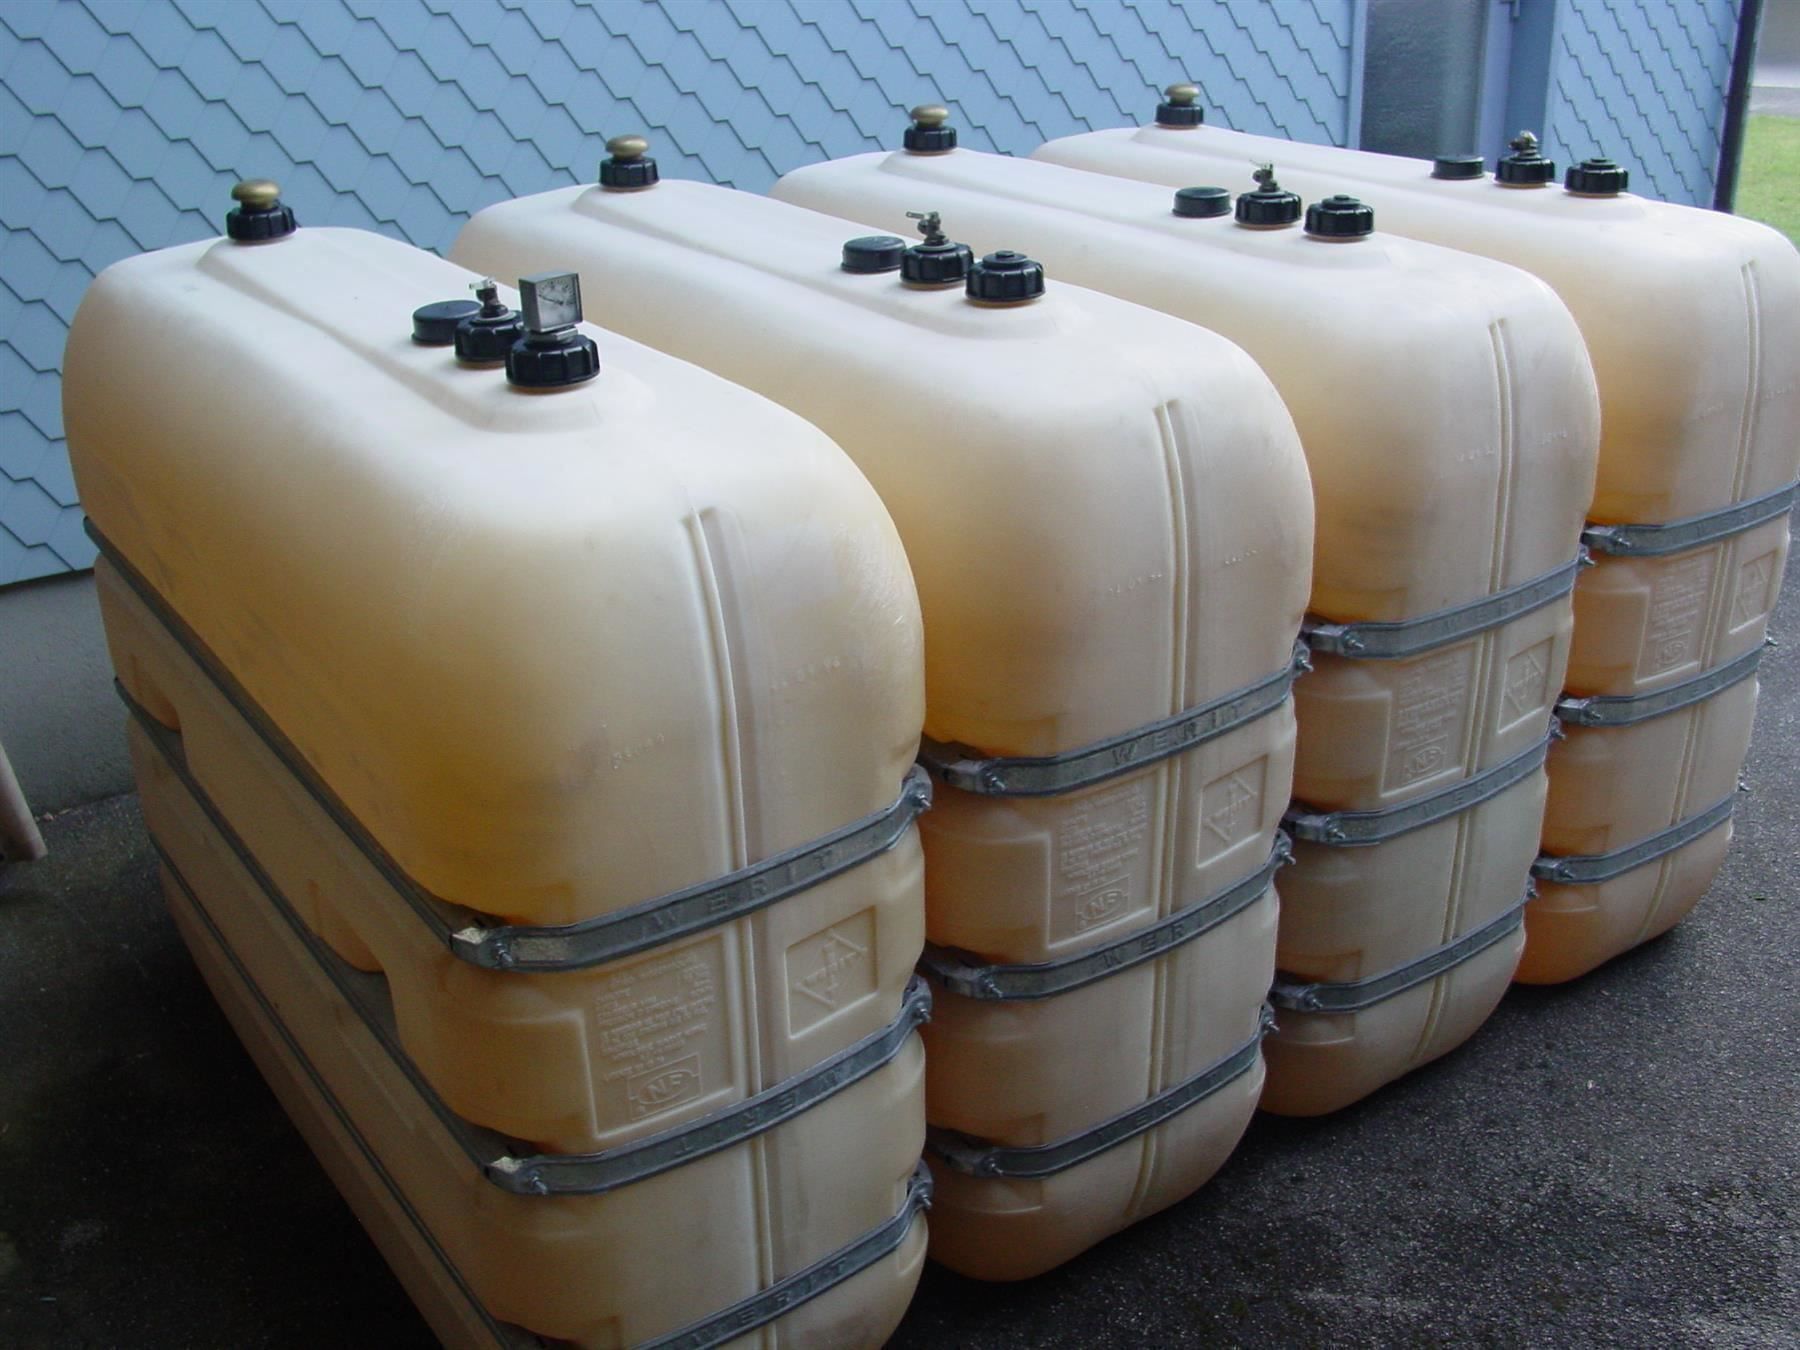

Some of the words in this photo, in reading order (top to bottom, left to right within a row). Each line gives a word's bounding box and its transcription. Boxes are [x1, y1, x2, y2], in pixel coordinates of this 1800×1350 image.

[1112, 702, 1242, 766] WERIT
[650, 848, 836, 930] WERIT
[645, 1073, 684, 1101] NF
